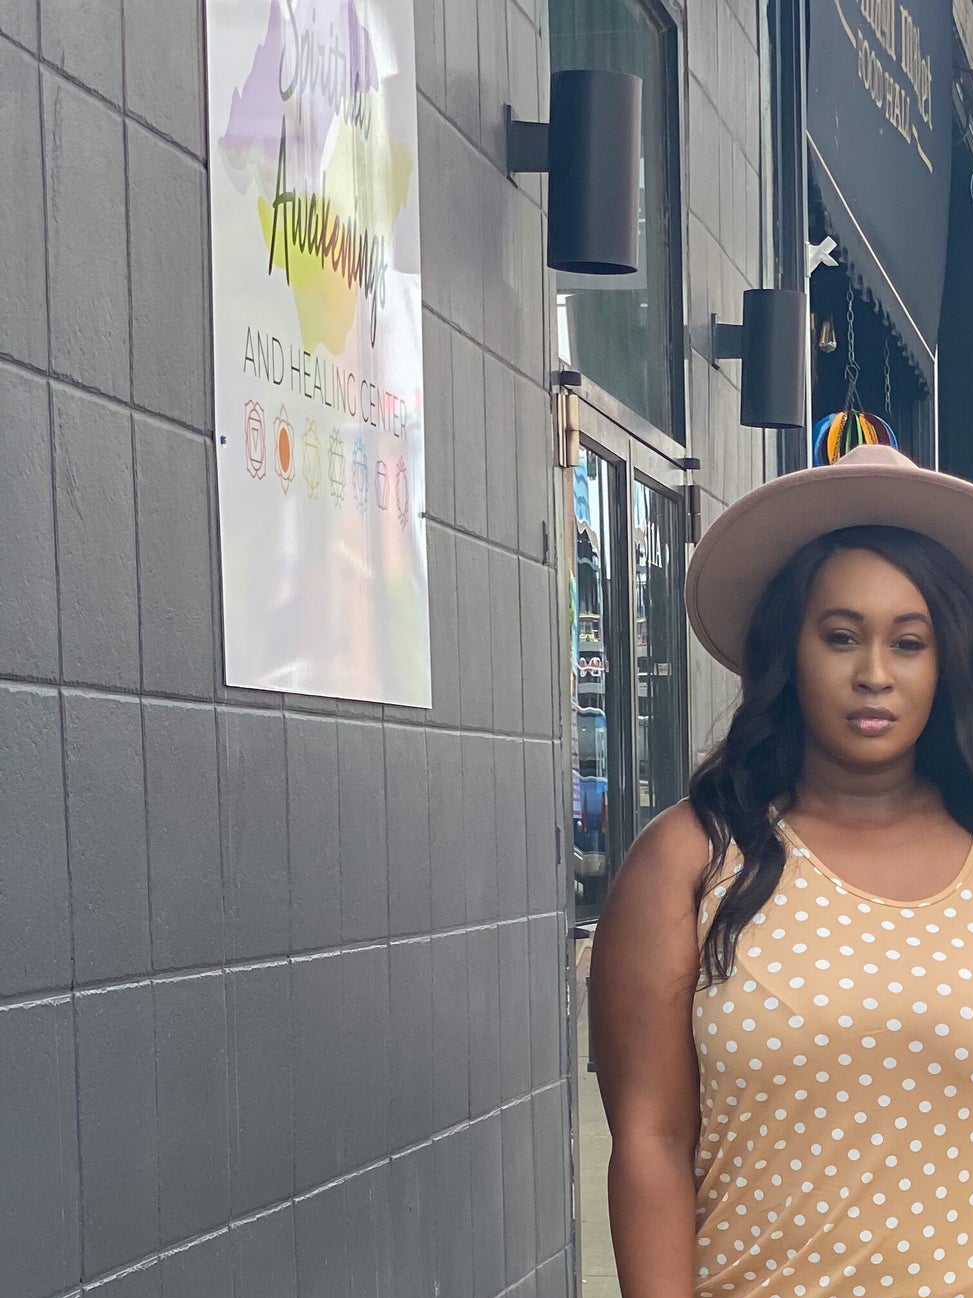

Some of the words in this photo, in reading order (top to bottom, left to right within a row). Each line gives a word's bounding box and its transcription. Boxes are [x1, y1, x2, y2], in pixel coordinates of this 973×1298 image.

[857, 28, 883, 109] FOOD
[883, 71, 911, 144] HALL
[243, 325, 285, 386] AND
[289, 343, 358, 417] HEALING
[359, 378, 408, 439] CENTER
